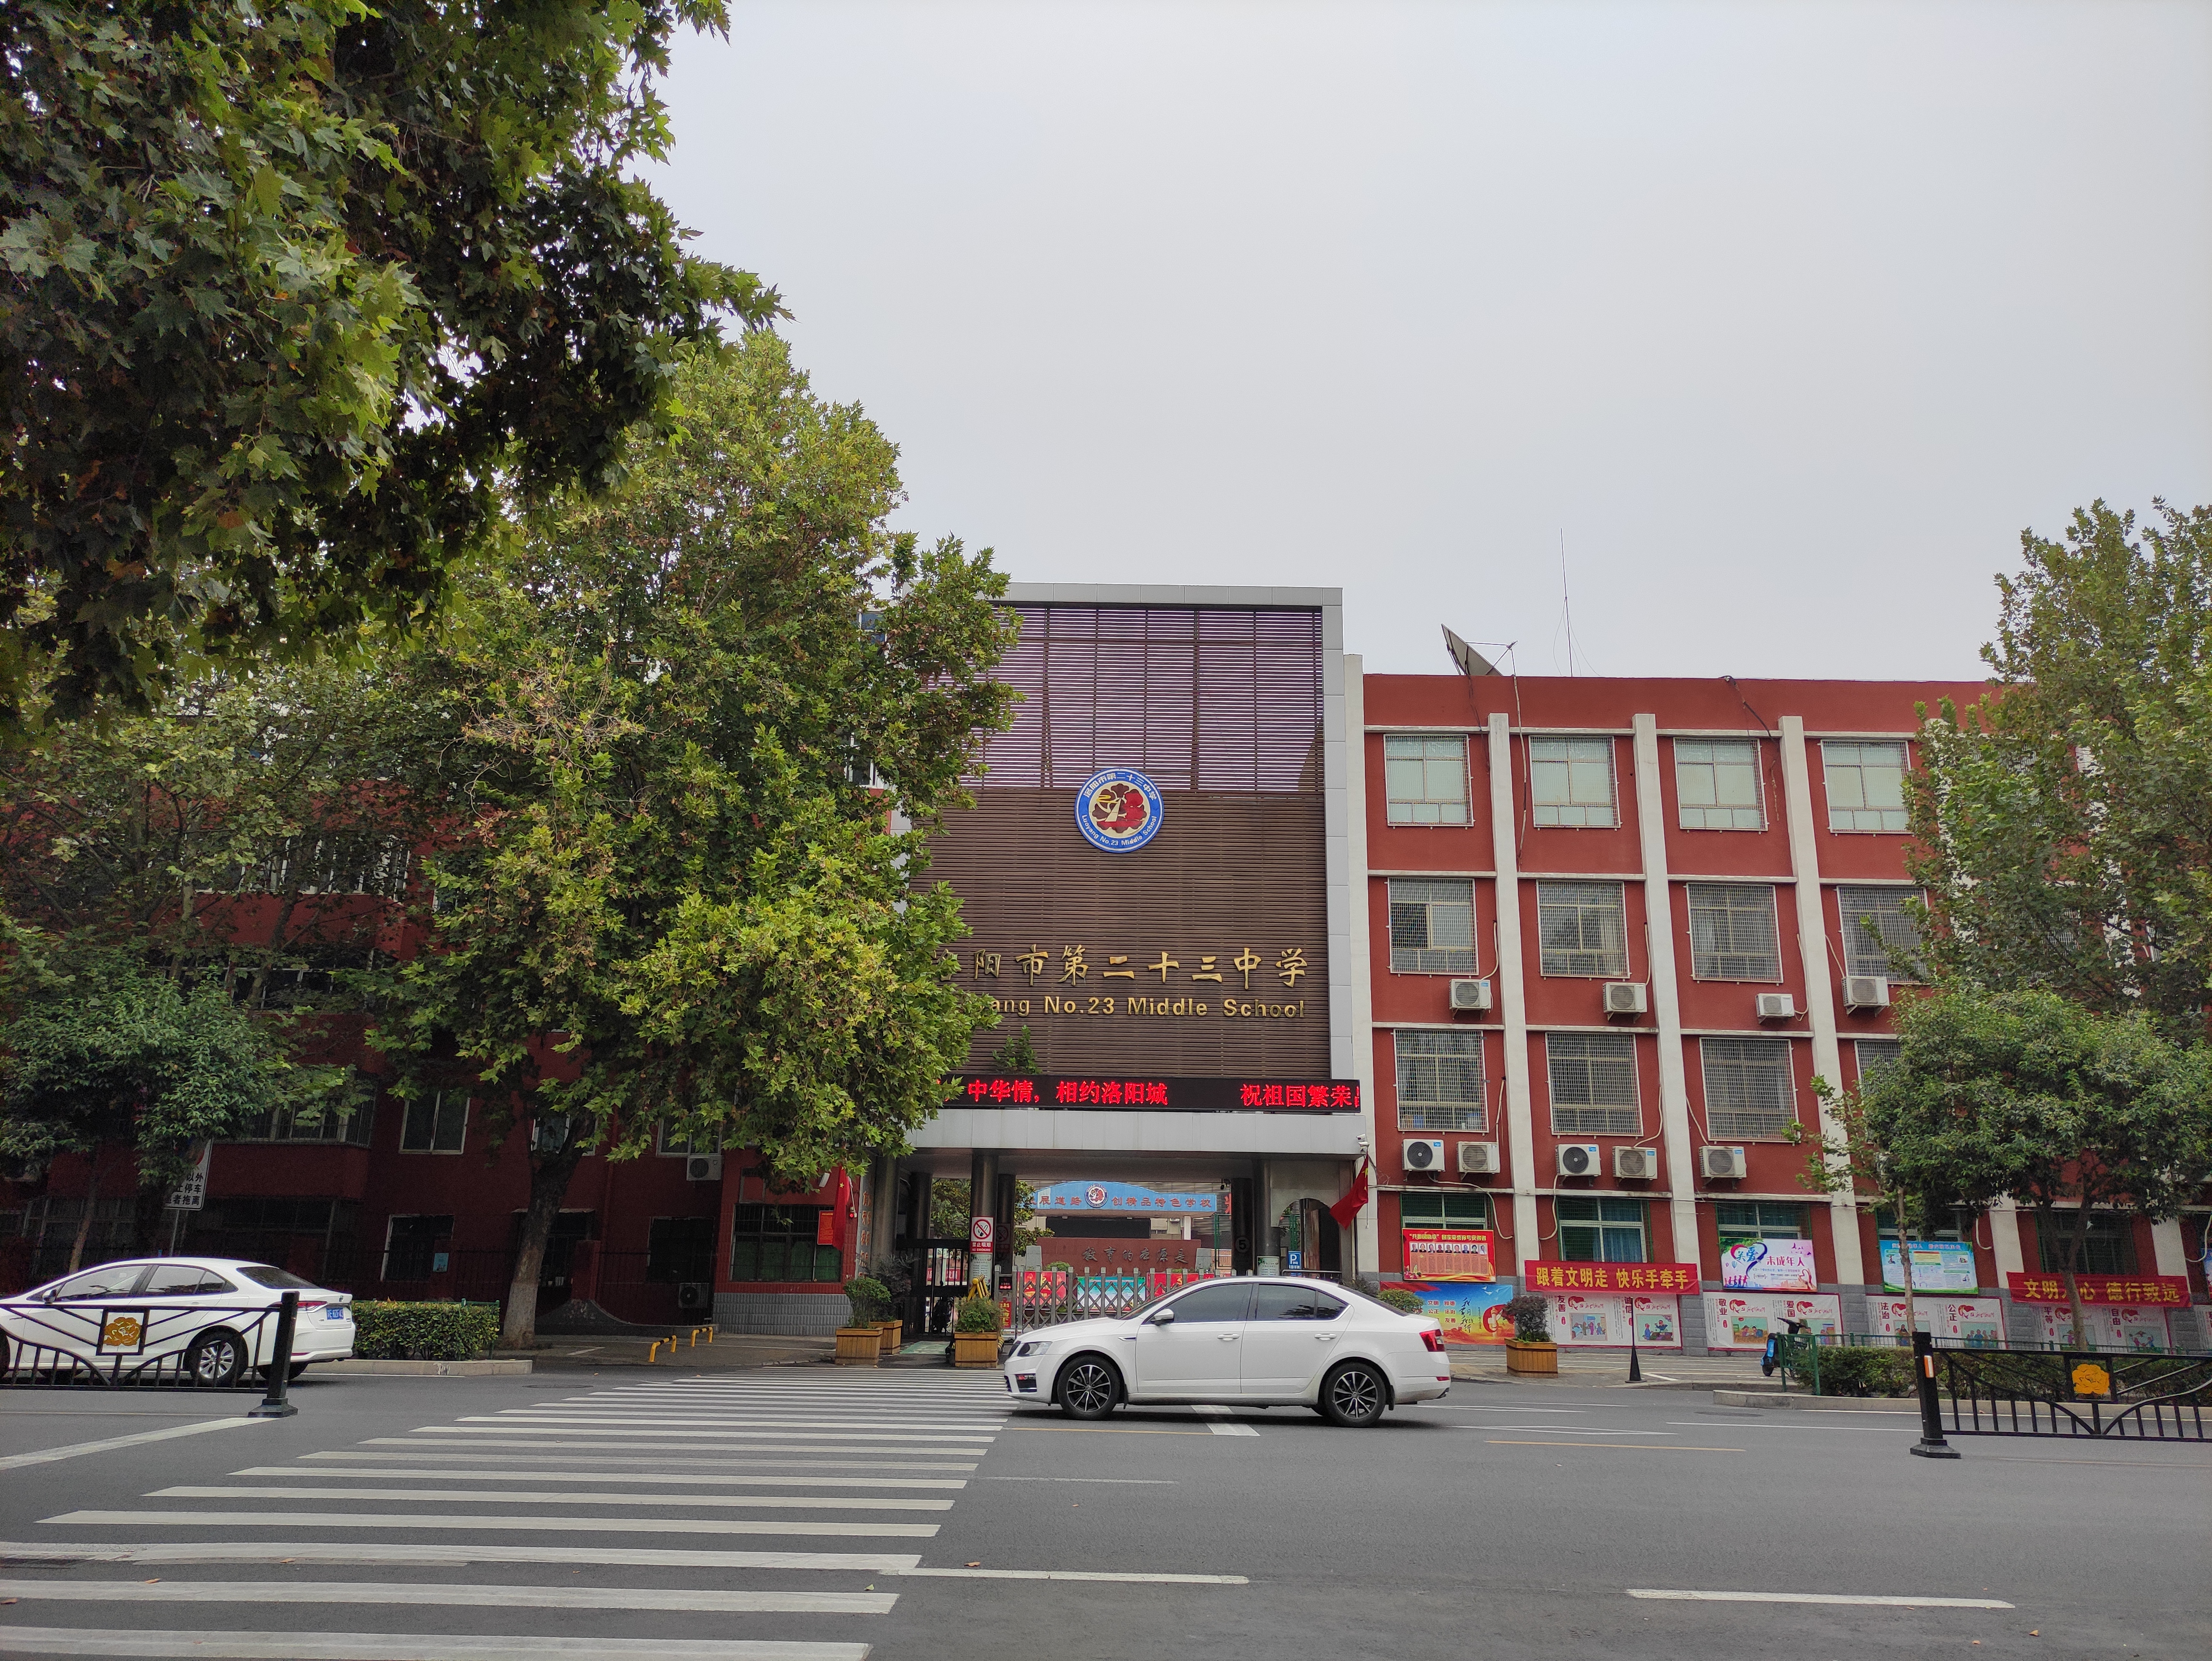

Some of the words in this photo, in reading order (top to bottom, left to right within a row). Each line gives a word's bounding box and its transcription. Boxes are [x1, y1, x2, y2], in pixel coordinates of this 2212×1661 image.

[1082, 814, 1099, 839] Luoyang
[1099, 836, 1118, 846] No.23
[1121, 835, 1143, 846] Middle
[1142, 816, 1157, 836] School
[981, 998, 1029, 1017] ang
[1044, 996, 1115, 1015] No.23
[1128, 997, 1207, 1016] Middle
[1224, 998, 1305, 1018] School
[1031, 1196, 1082, 1207] 展道路
[1111, 1196, 1212, 1208] 创精品特色学校
[1239, 1240, 1247, 1250] 5
[1290, 1254, 1297, 1264] P
[1766, 1255, 1805, 1267] 未成年人
[1536, 1266, 1608, 1287] 跟着文明走
[1616, 1268, 1689, 1289] 快乐手牵手
[2106, 1281, 2180, 1302] 德行致远
[1557, 1295, 1566, 1312] 友善
[1718, 1298, 1728, 1316] 敬业
[1787, 1300, 1795, 1318] 爱国
[1881, 1302, 1890, 1319] 法治
[1948, 1304, 1958, 1321] 公正
[2044, 1307, 2053, 1323] 平等
[2112, 1308, 2121, 1325] 自由
